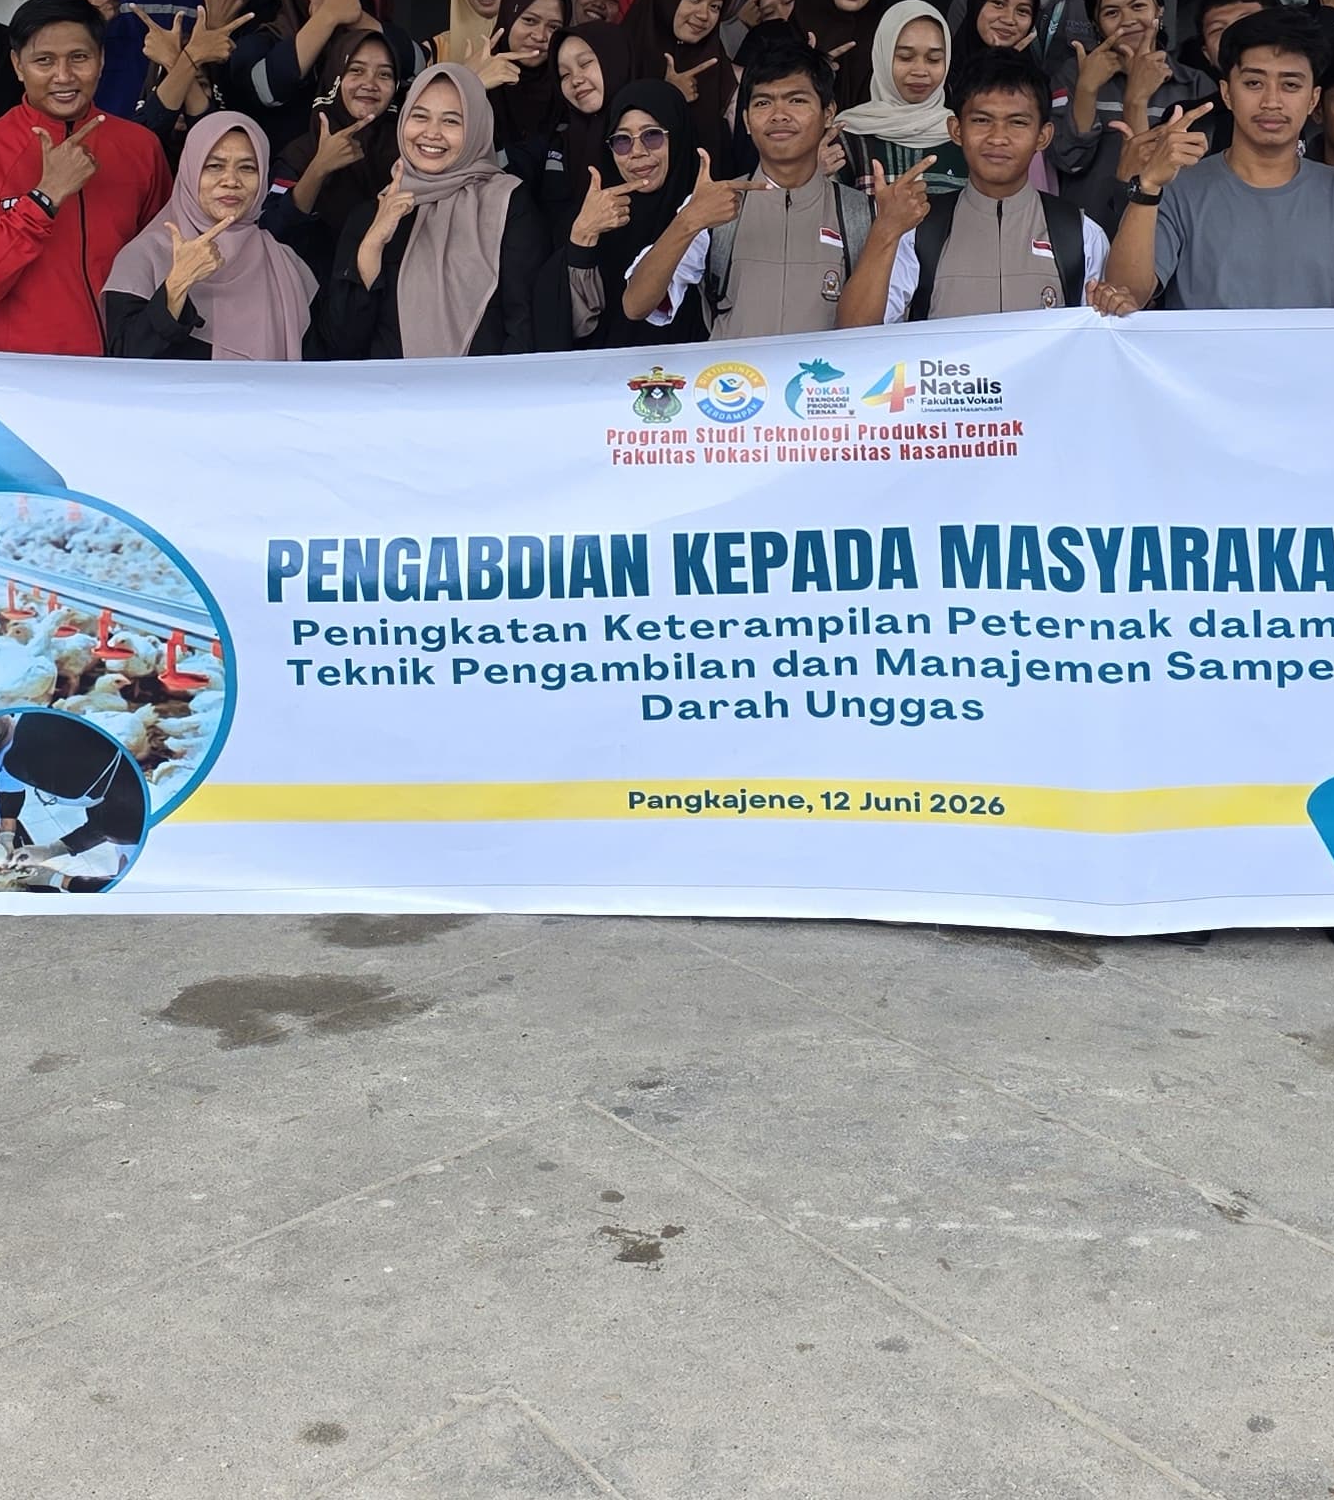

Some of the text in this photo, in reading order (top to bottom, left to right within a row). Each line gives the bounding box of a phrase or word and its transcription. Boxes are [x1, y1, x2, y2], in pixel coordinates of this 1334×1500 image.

[920, 360, 971, 377] Dies
[806, 386, 850, 396] VOKASI
[920, 378, 1002, 395] Natalis
[921, 396, 1003, 405] Fakultas Vokasi
[606, 420, 1024, 446] Program Studi Teknologi Produksi Ternak
[612, 440, 1018, 465] Fakultas Vokasi Universitas Hasanuddin
[267, 533, 650, 602] PENGABDIAN
[673, 527, 918, 596] KEPADA
[293, 617, 588, 652] Peningkatan
[604, 607, 931, 644] Keterampilan
[948, 606, 1172, 640] Peternak
[287, 658, 436, 686] Teknik
[452, 651, 756, 690] Pengambilan
[772, 649, 858, 677] dan
[876, 647, 1151, 687] Manajemen
[641, 690, 985, 727] Darah Unggas
[628, 789, 1006, 816] Pangkajene, 12 Juni 2026
